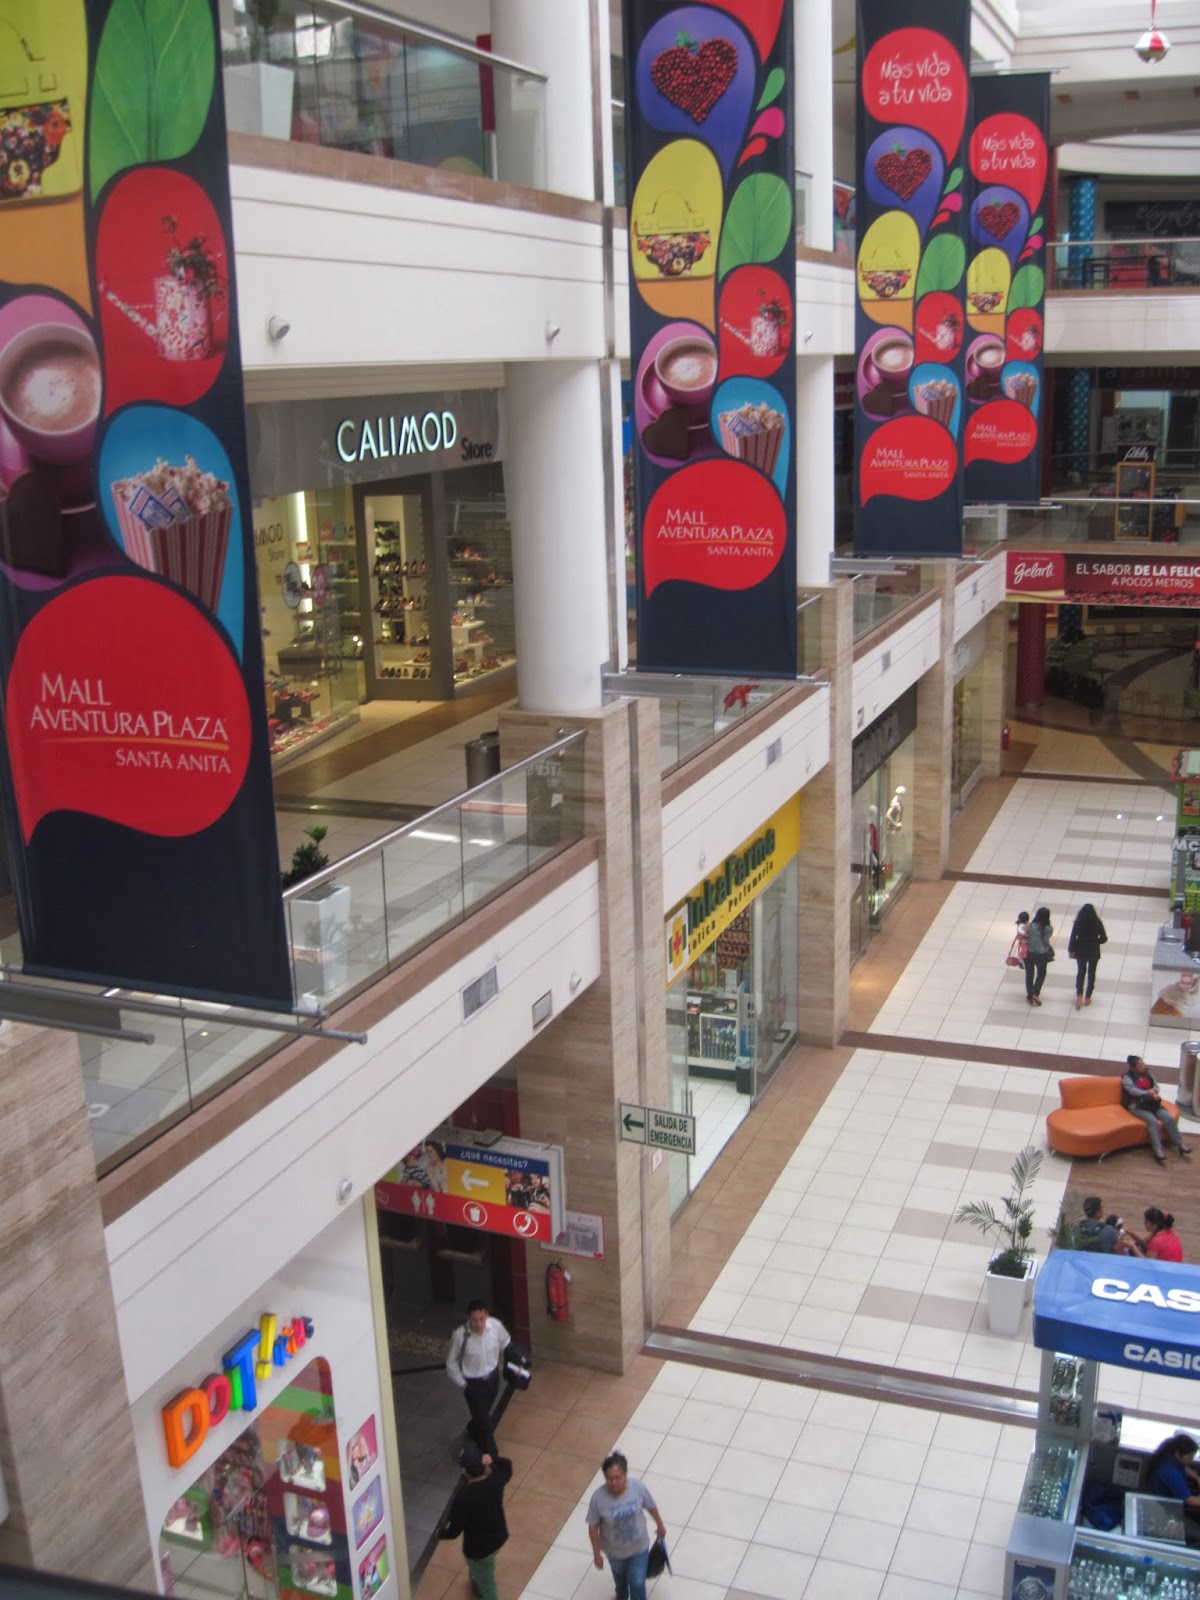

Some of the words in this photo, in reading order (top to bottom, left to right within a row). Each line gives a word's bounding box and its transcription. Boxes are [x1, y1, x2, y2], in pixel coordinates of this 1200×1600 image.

[881, 52, 912, 79] Más
[917, 51, 950, 76] vida
[878, 90, 890, 105] a
[893, 80, 915, 105] tu
[918, 78, 953, 103] vida
[1009, 132, 1035, 150] vida
[992, 152, 1008, 170] tu
[1010, 150, 1037, 169] vida
[337, 411, 457, 463] CALIMOD
[461, 438, 493, 462] Store
[656, 524, 729, 540] AVENTURA
[730, 525, 775, 541] PLAZA
[706, 545, 741, 556] SANTA
[742, 546, 775, 557] ANITA
[1075, 562, 1090, 576] EL
[1092, 563, 1132, 577] SABOR
[1133, 564, 1151, 577] DE
[1152, 565, 1168, 577] LA
[1111, 578, 1119, 587] A
[1120, 578, 1154, 588] POCOS
[1155, 578, 1195, 589] METROS
[41, 672, 112, 706] MALL
[30, 704, 151, 737] AVENTURA
[152, 710, 230, 742] PLAZA
[115, 748, 174, 770] SANTA
[176, 752, 232, 775] ANITA
[654, 1113, 678, 1131] SALIDA
[678, 1118, 689, 1133] DE
[650, 1129, 693, 1151] EMERGENCIA
[482, 1153, 529, 1170] necesitas?
